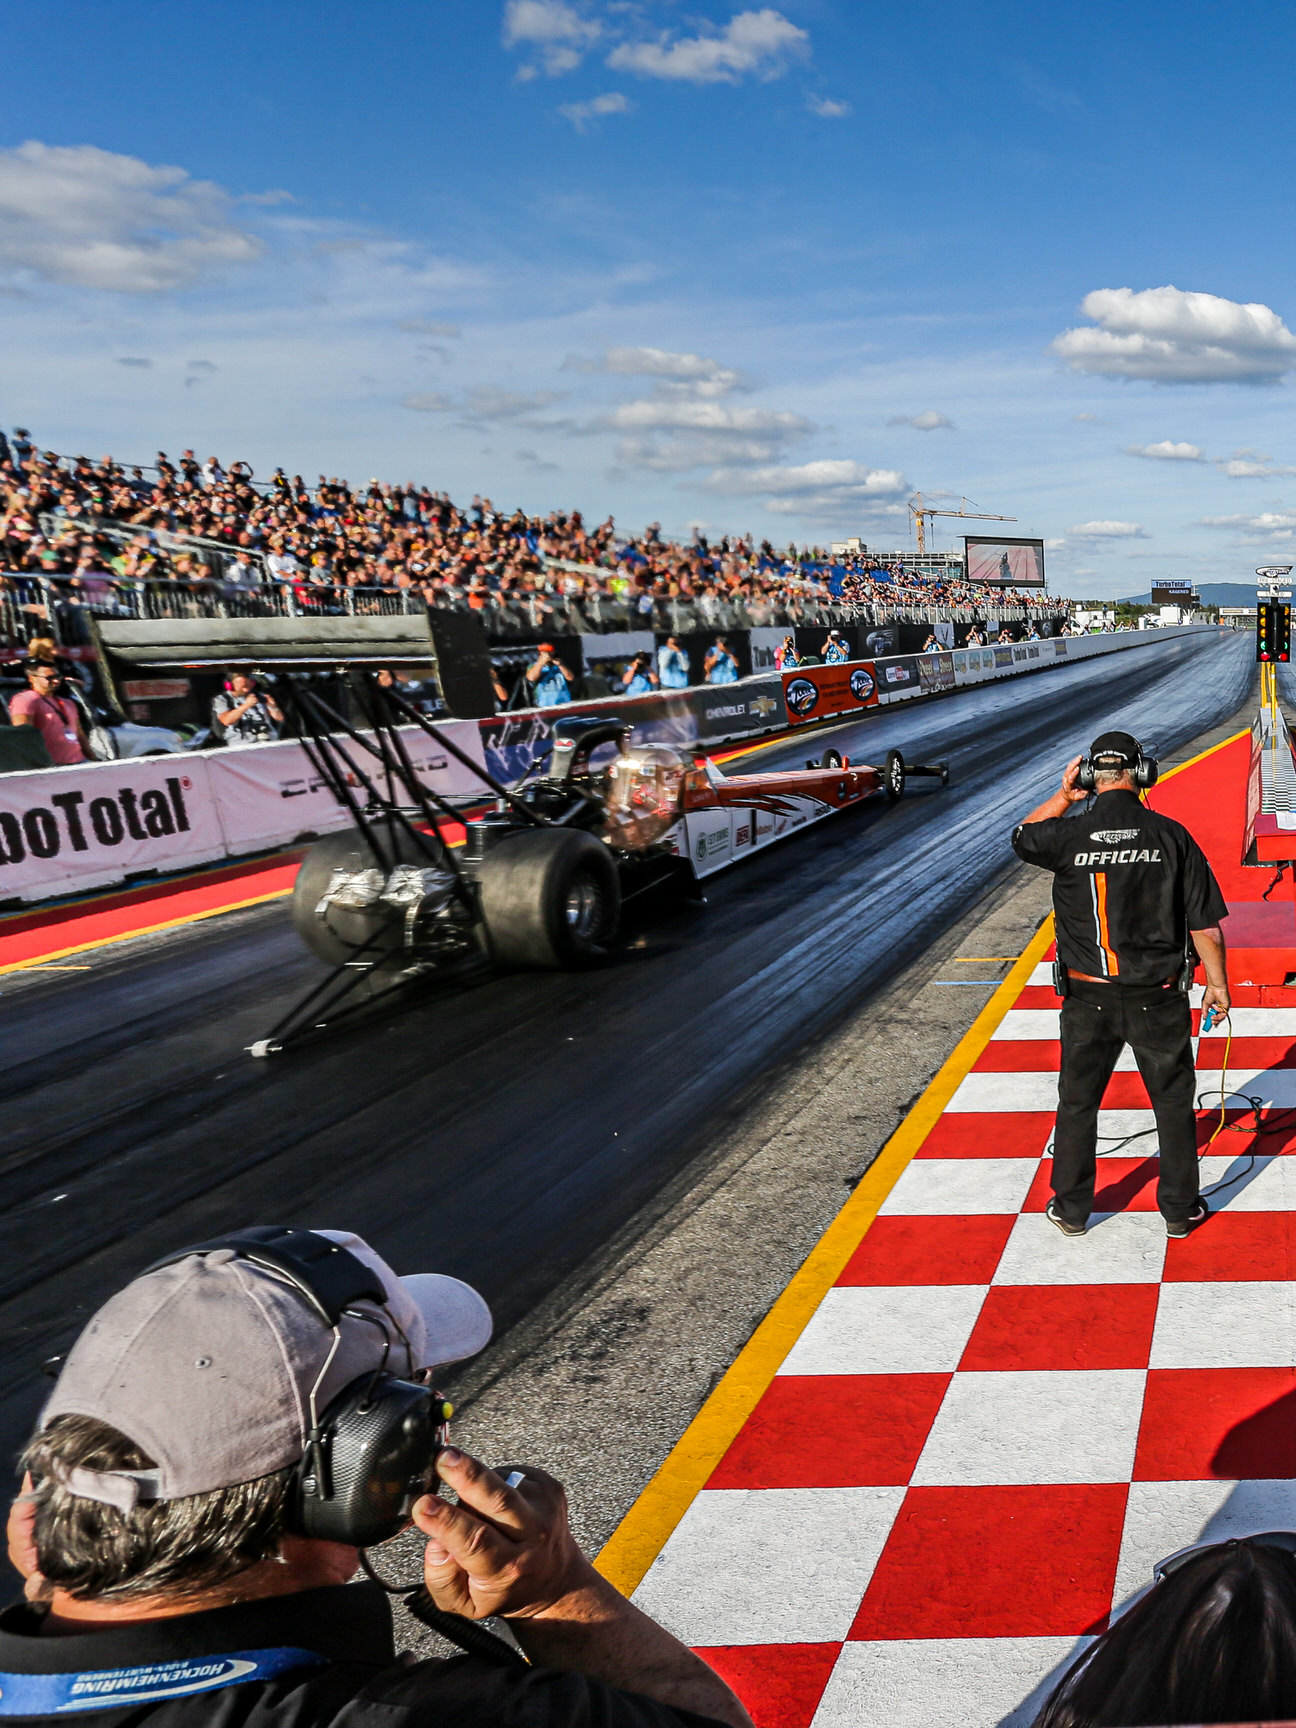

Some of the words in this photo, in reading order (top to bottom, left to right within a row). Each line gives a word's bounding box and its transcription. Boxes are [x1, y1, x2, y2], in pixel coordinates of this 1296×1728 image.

[705, 704, 746, 720] CHEVROLET
[1074, 849, 1162, 867] OFFICIAL
[72, 1663, 224, 1695] HOCKENHEIMRING
